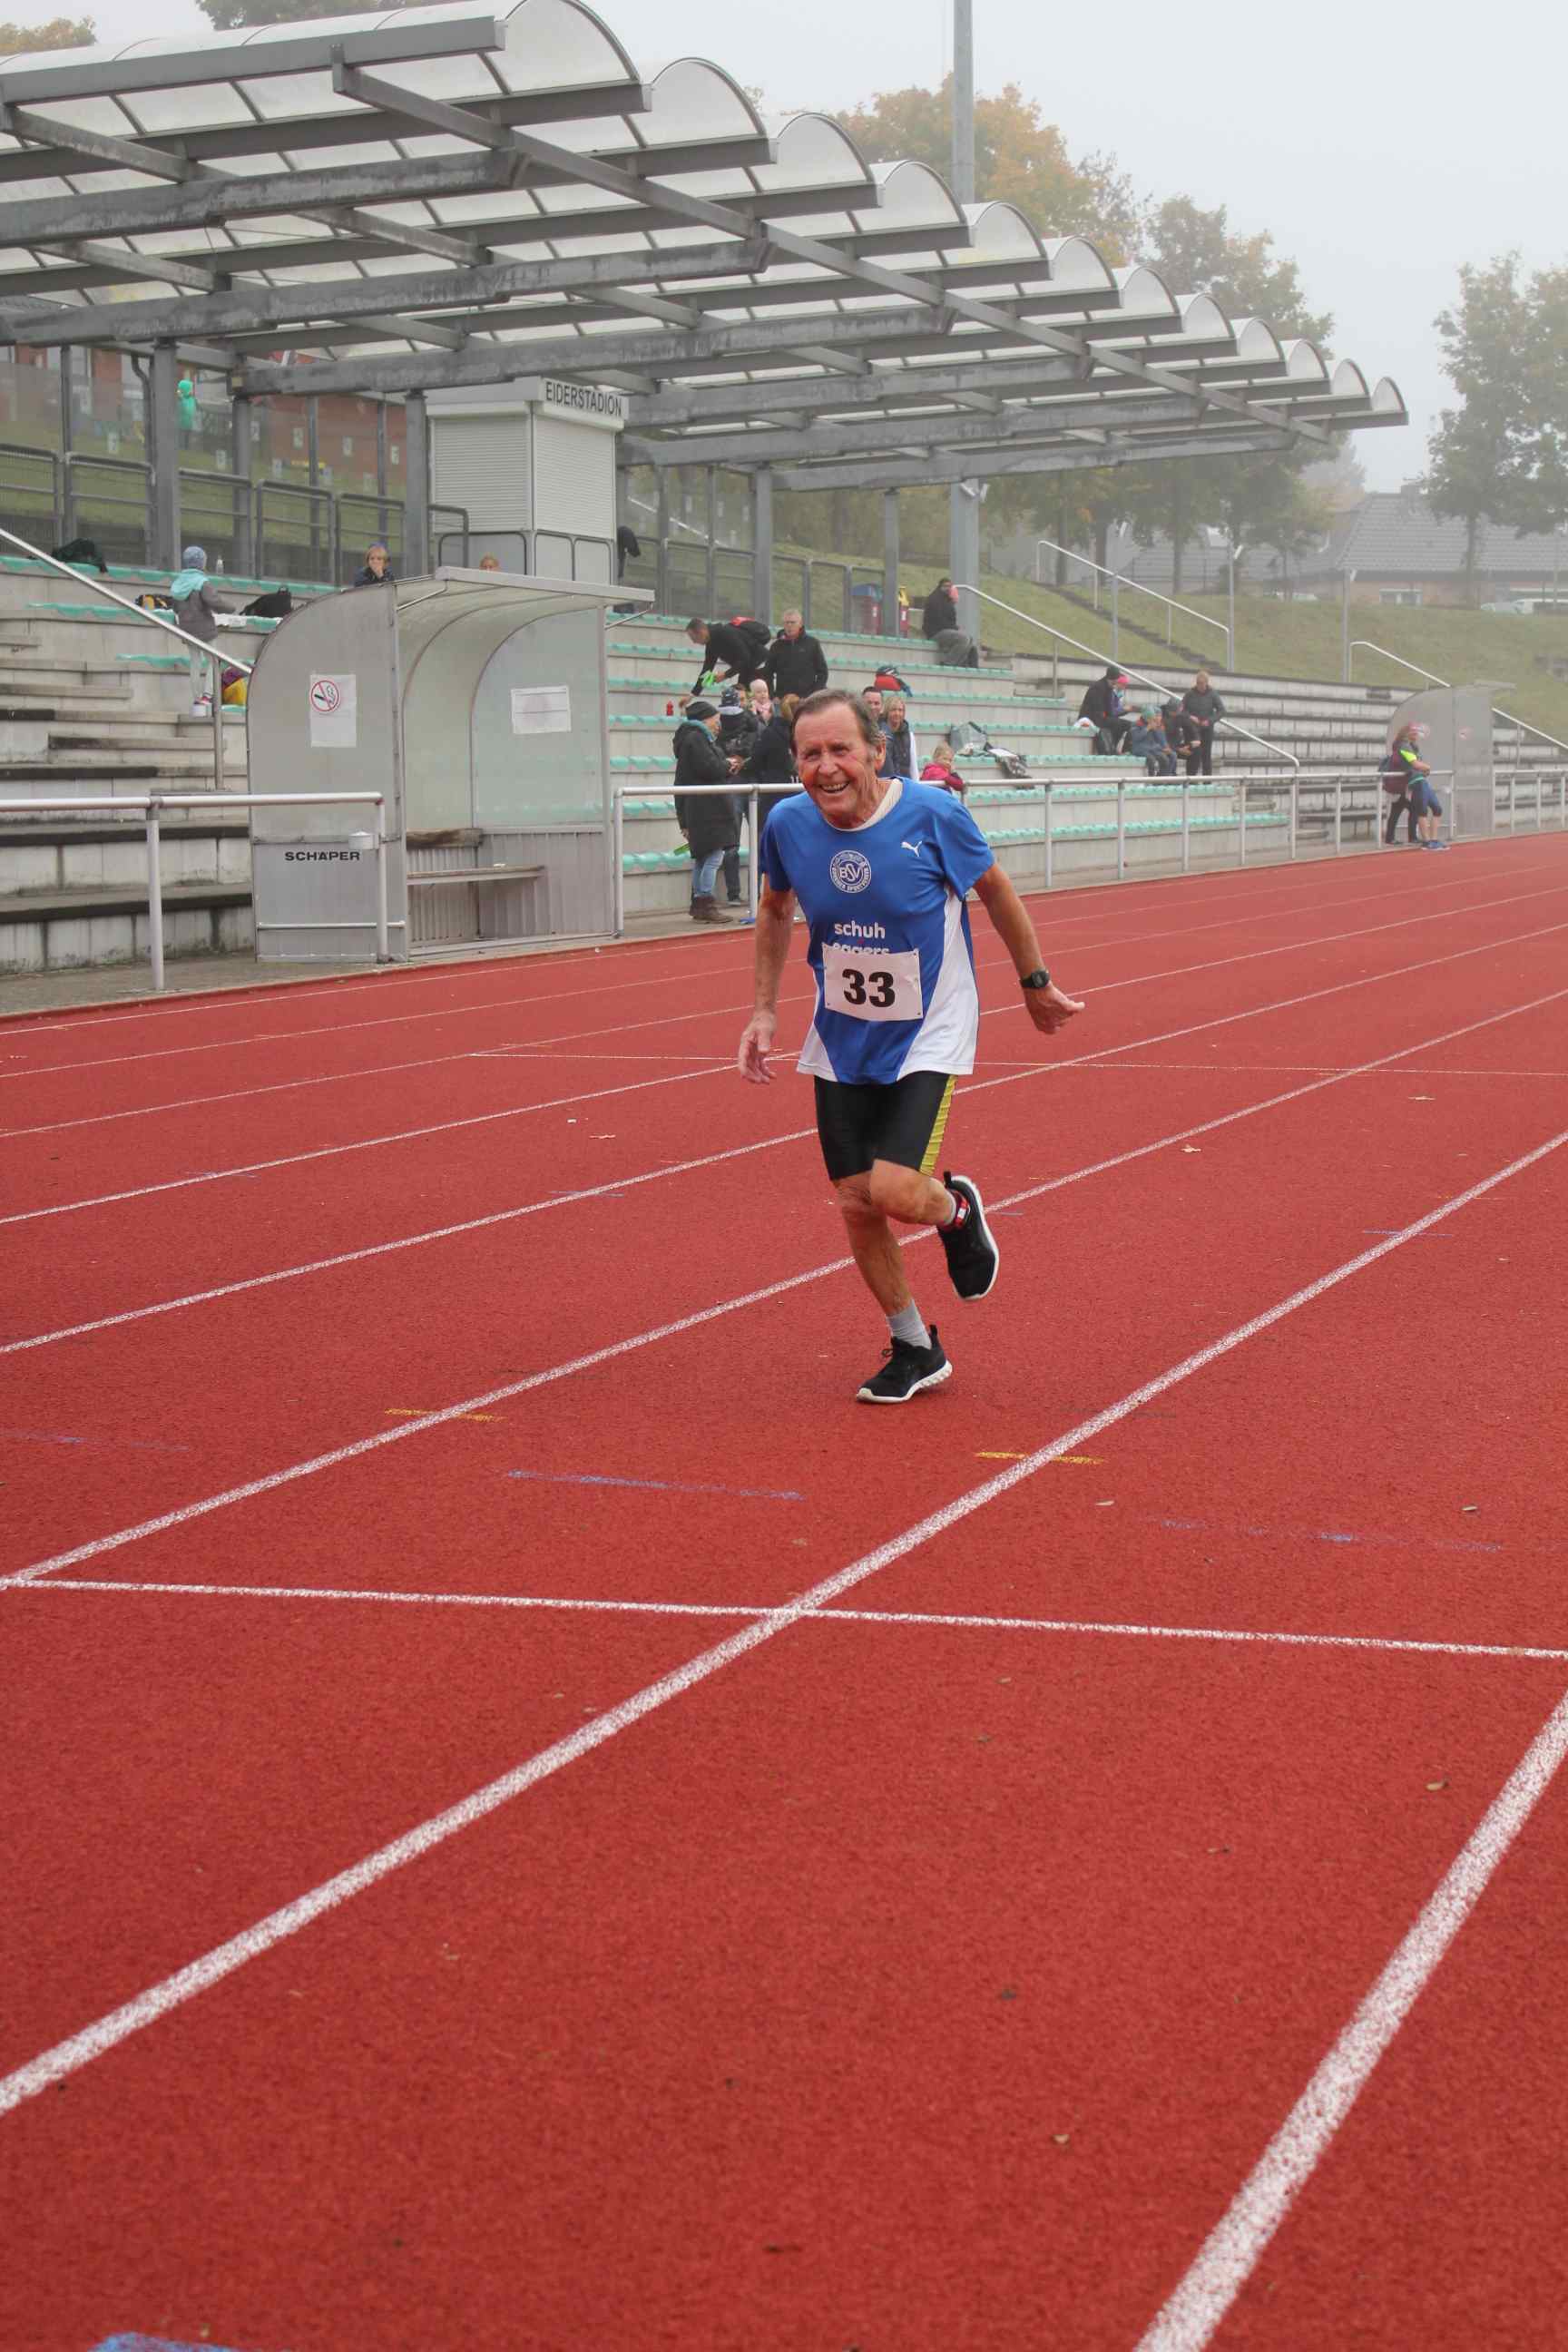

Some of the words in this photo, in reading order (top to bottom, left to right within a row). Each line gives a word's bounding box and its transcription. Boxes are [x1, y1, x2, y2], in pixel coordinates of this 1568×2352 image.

[545, 381, 622, 416] EIDERSTADION
[284, 851, 360, 861] SCHÄPER
[839, 863, 861, 882] BSV
[834, 920, 886, 939] schuh
[842, 968, 896, 1008] 33
